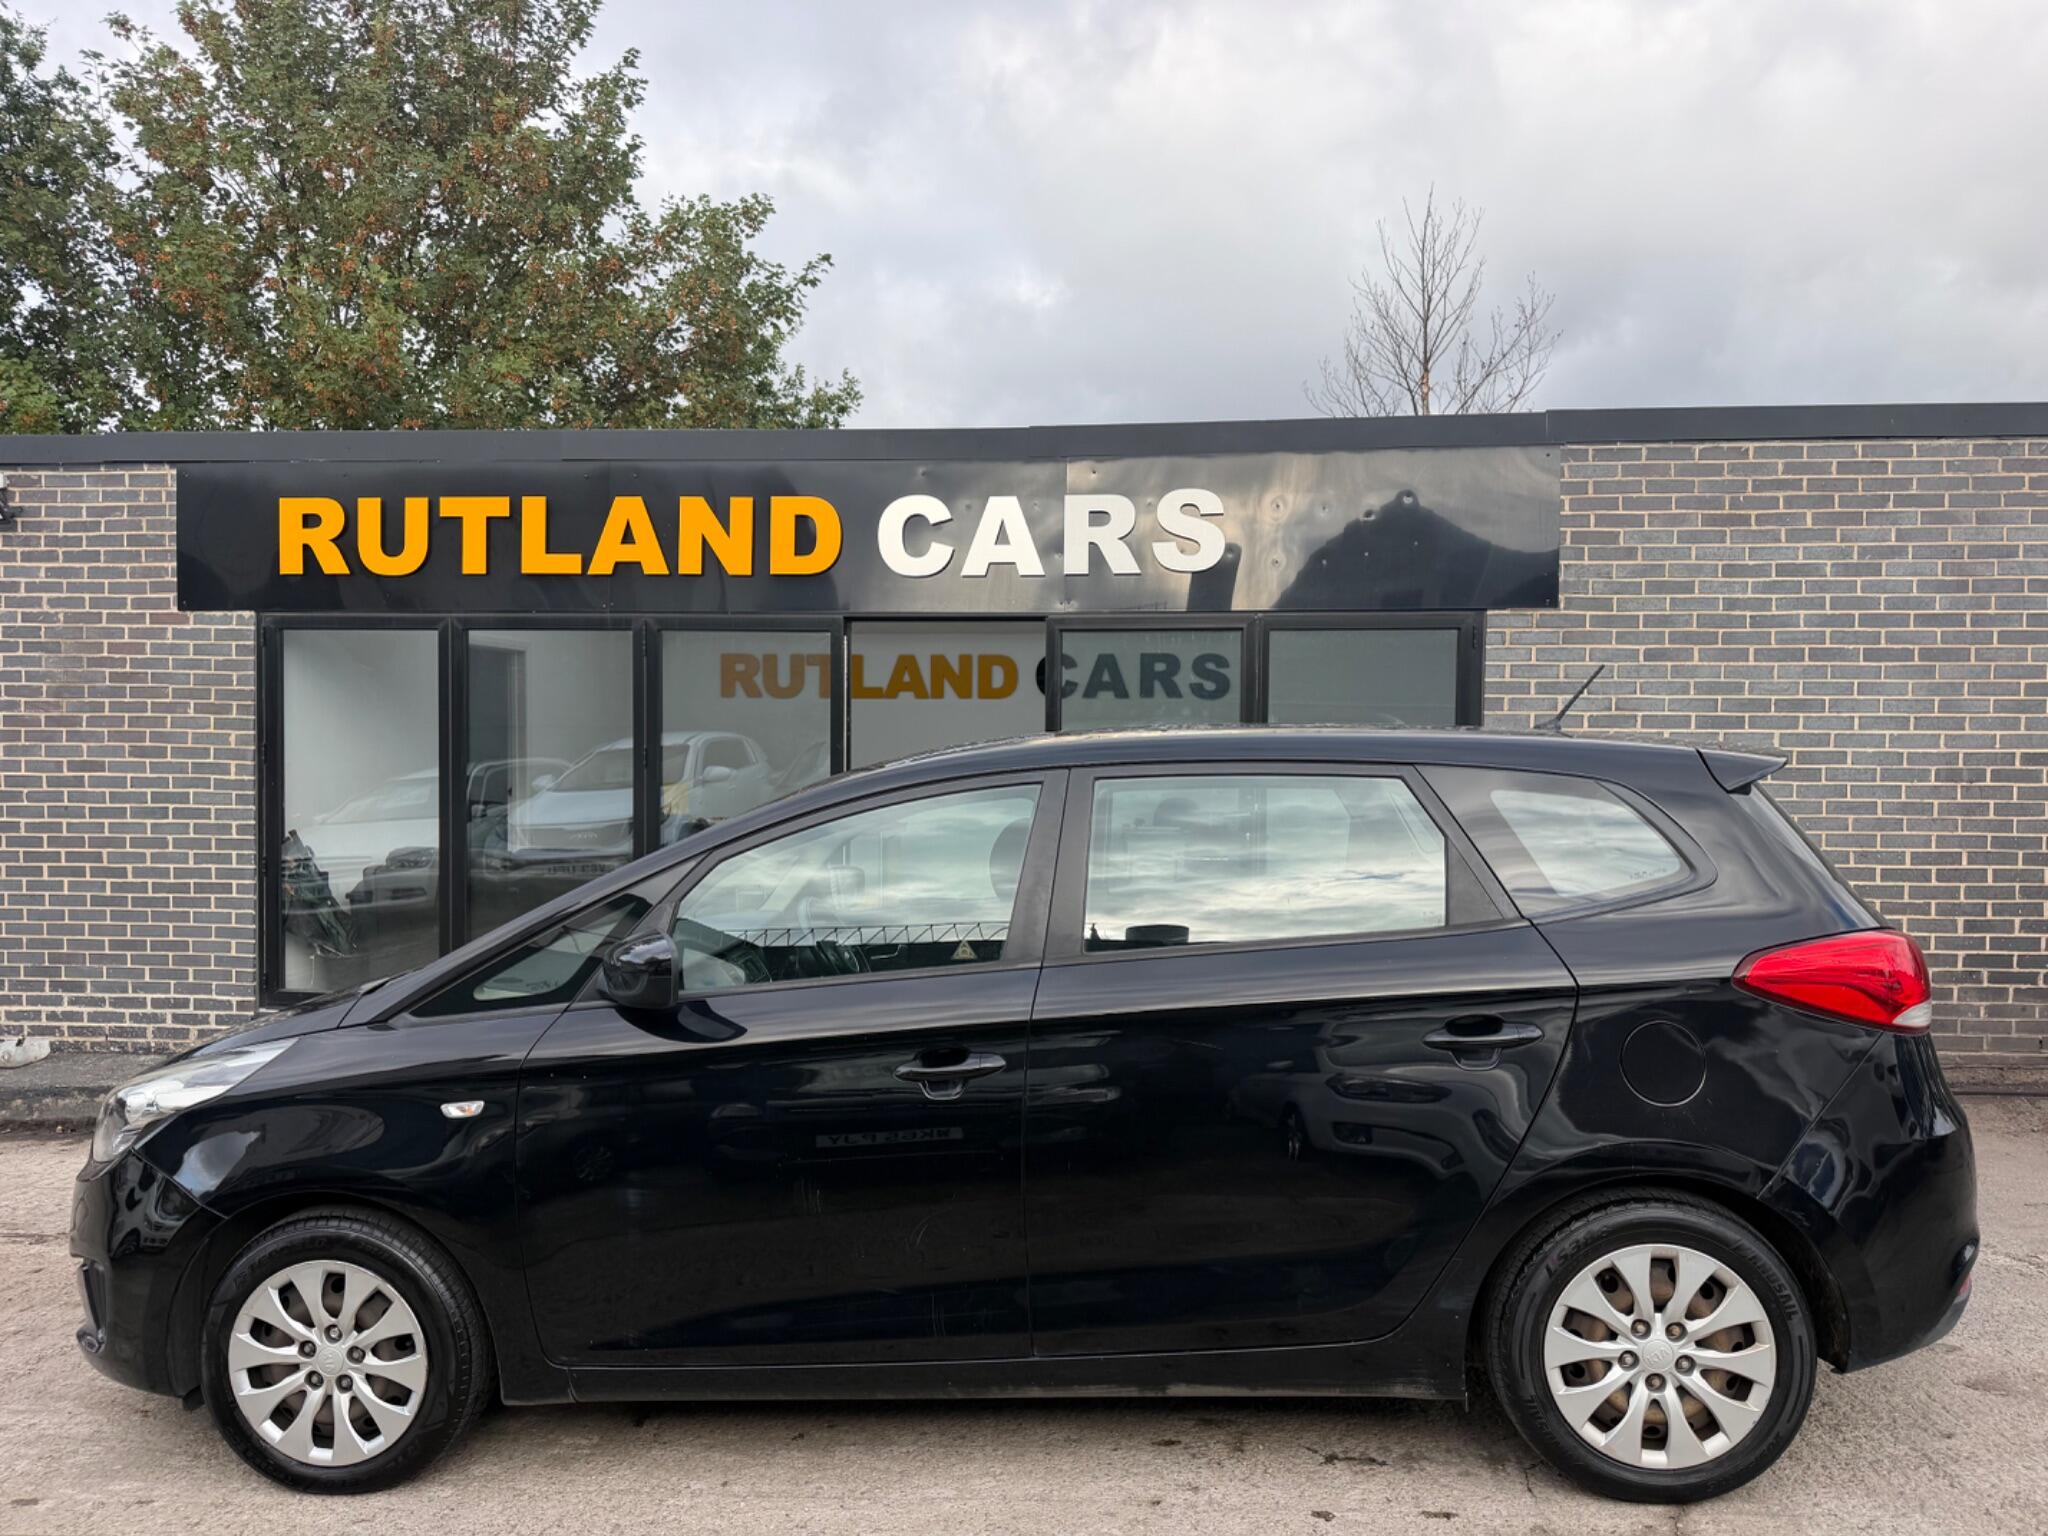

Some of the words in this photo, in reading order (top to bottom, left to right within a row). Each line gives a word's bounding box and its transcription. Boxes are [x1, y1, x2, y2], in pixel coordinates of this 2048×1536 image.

[278, 494, 844, 577] RUTLAND
[877, 488, 1227, 578] CARS
[720, 652, 1018, 700] RUTLAND
[1035, 652, 1231, 700] CARS
